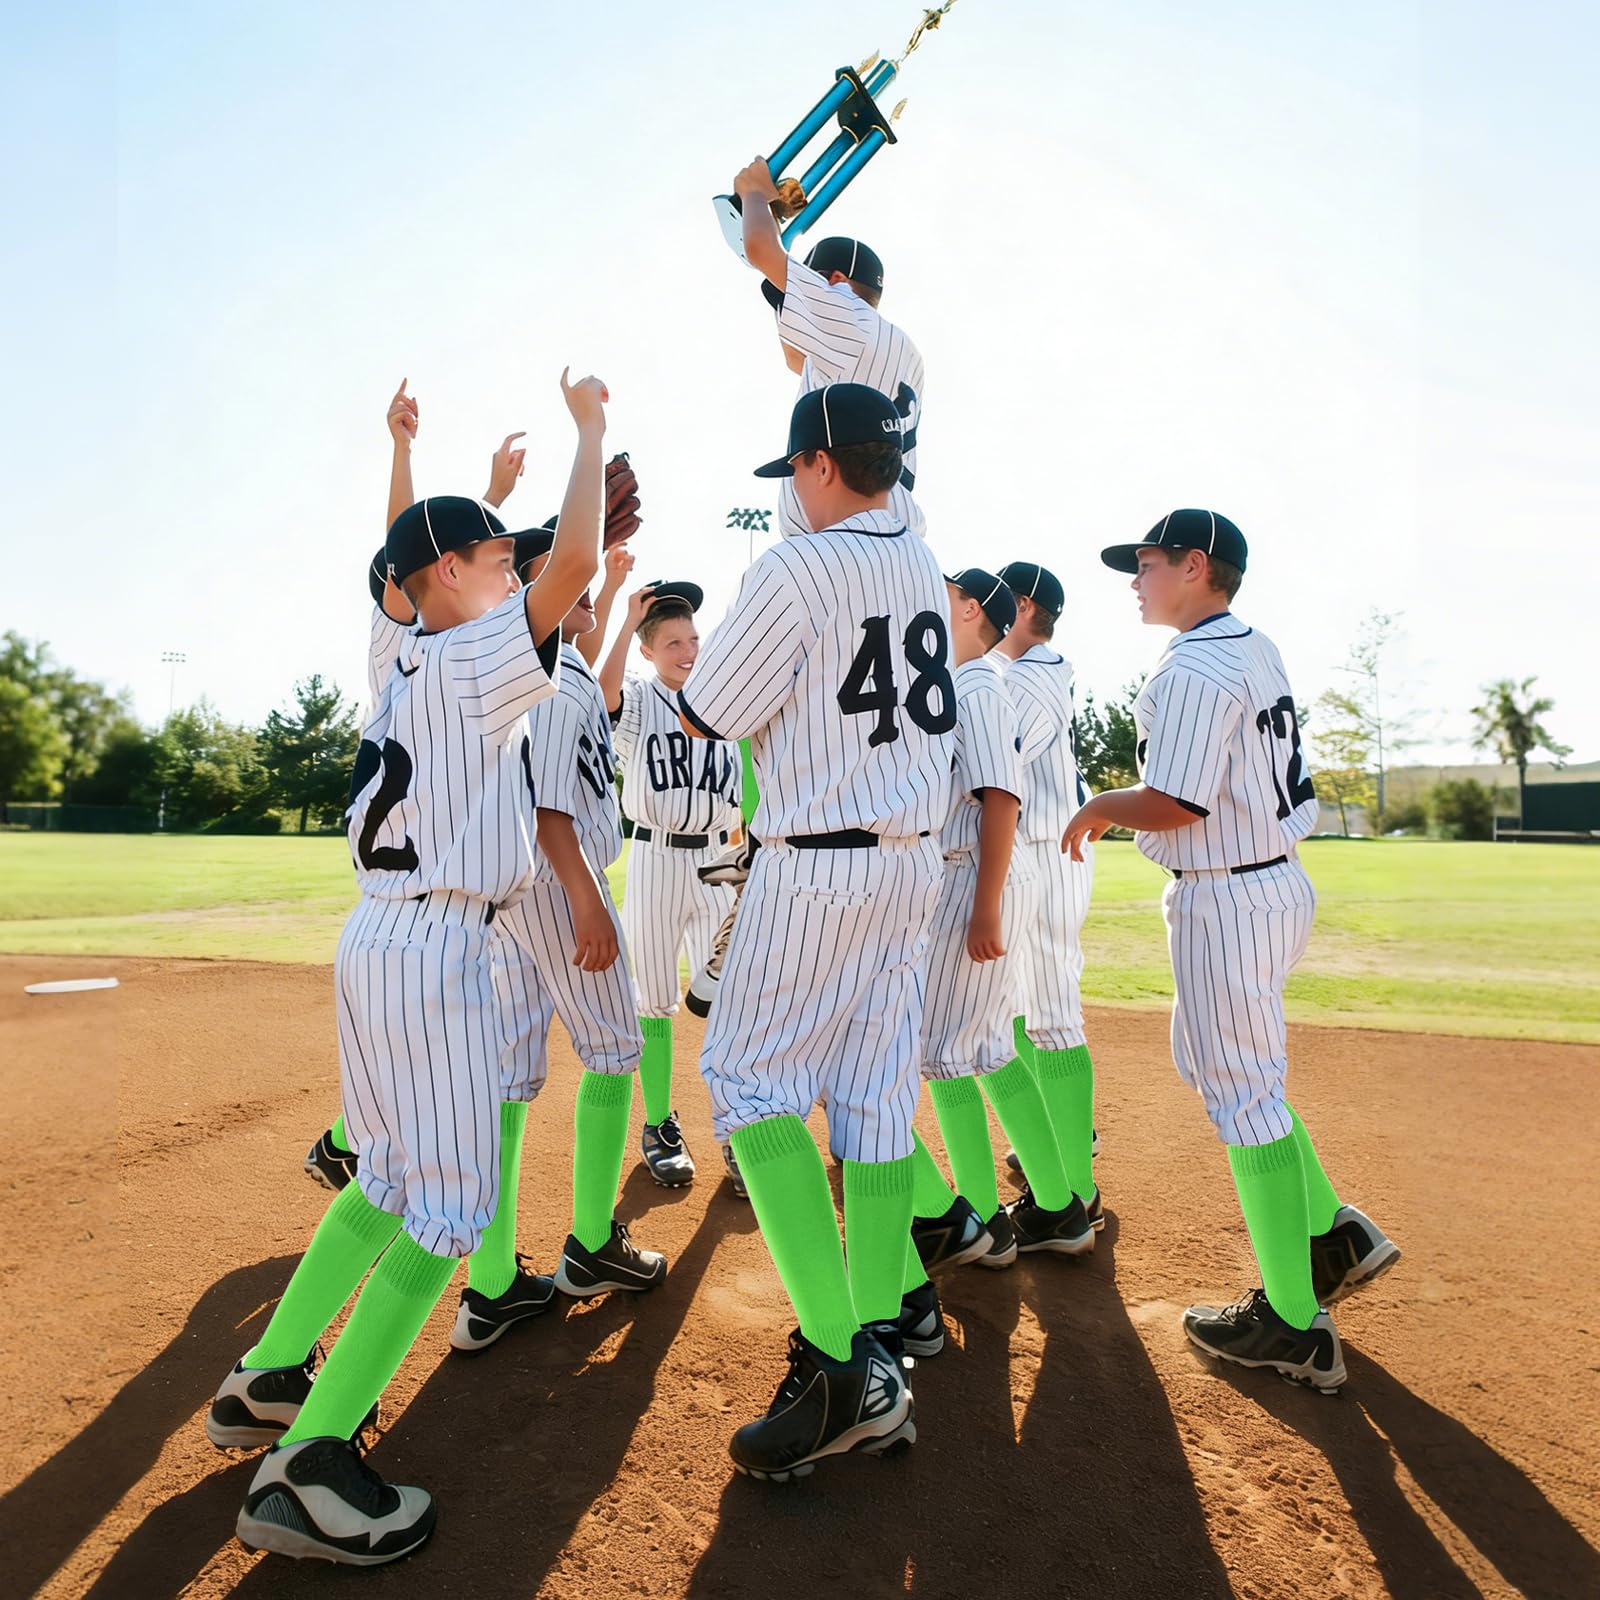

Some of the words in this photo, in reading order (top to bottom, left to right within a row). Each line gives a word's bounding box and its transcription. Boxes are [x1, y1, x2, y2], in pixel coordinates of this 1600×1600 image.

[836, 610, 957, 749] 48
[345, 737, 420, 874] 2
[1256, 695, 1316, 821] 12
